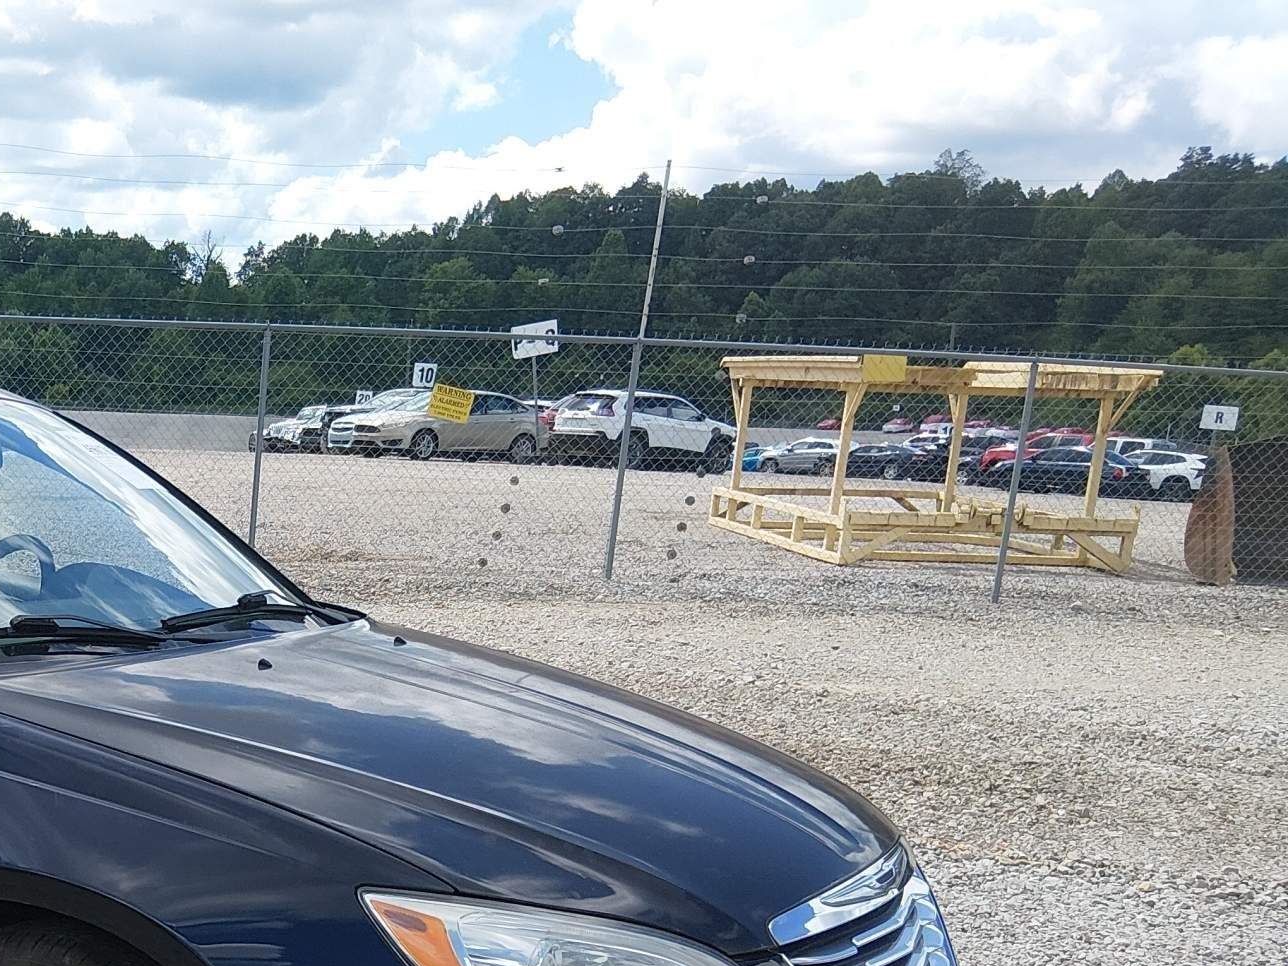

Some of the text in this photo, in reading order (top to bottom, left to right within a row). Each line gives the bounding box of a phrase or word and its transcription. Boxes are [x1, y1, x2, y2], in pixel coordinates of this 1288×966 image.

[418, 366, 434, 384] 10
[437, 385, 472, 400] WARNING
[437, 397, 465, 409] ALARMED
[1214, 411, 1224, 424] R
